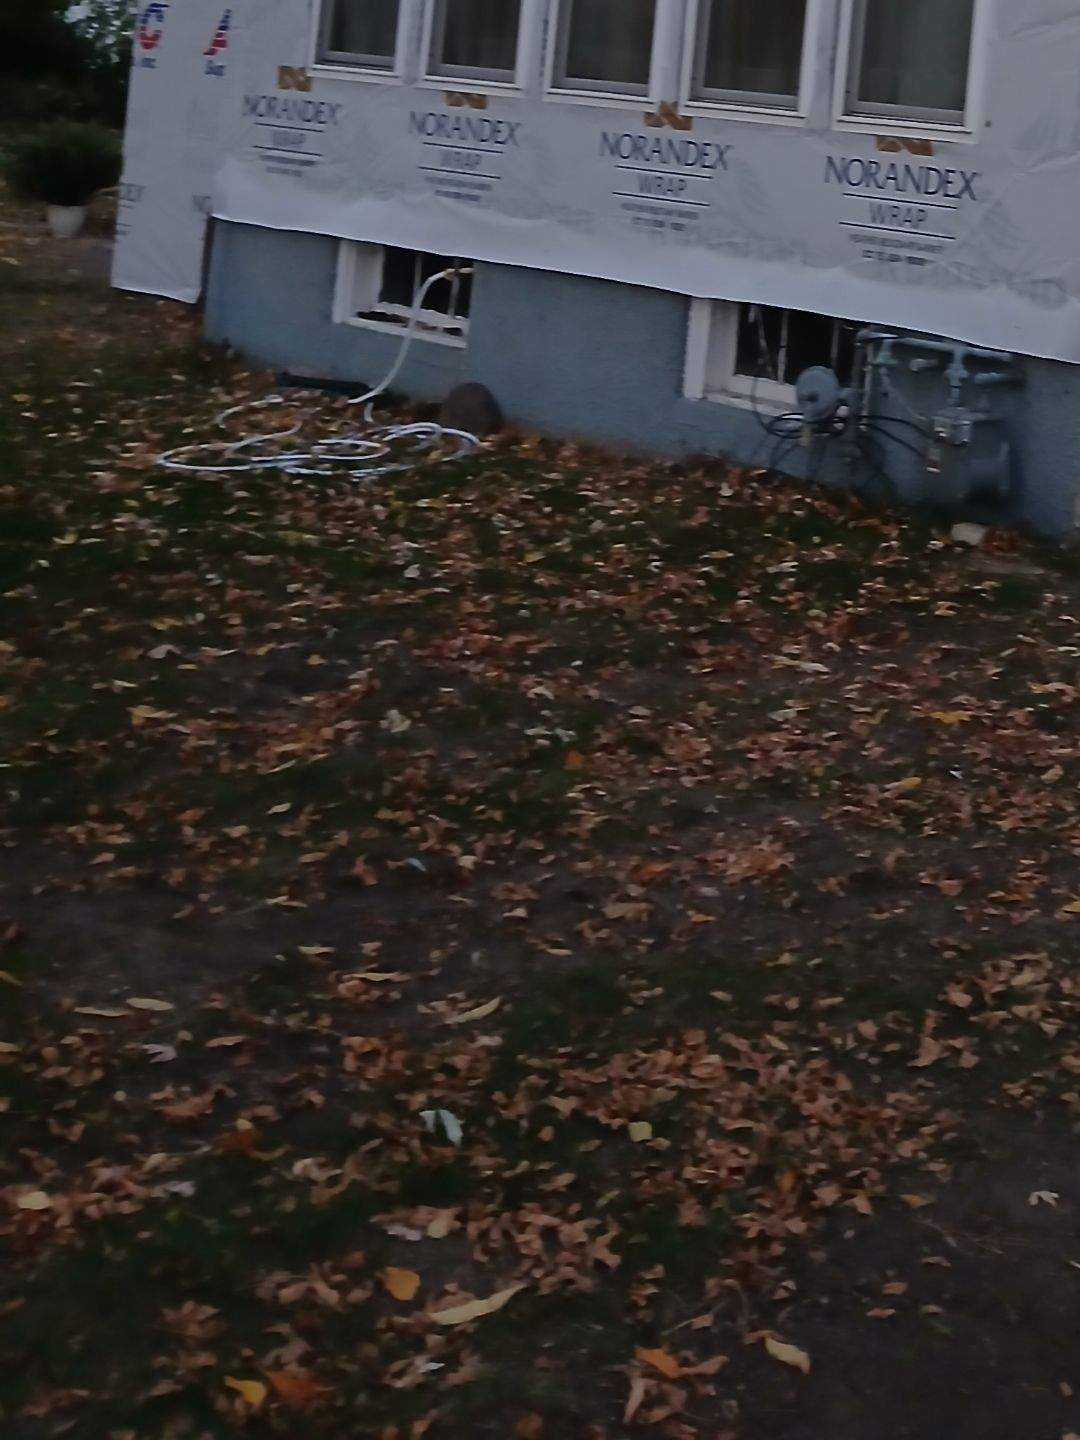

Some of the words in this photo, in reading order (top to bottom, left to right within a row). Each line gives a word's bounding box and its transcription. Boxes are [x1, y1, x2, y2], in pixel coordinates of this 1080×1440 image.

[408, 110, 525, 147] NORANDEX
[599, 130, 736, 172] NORANDEX
[823, 155, 982, 202] NORANDEX
[868, 201, 929, 229] WRAP
